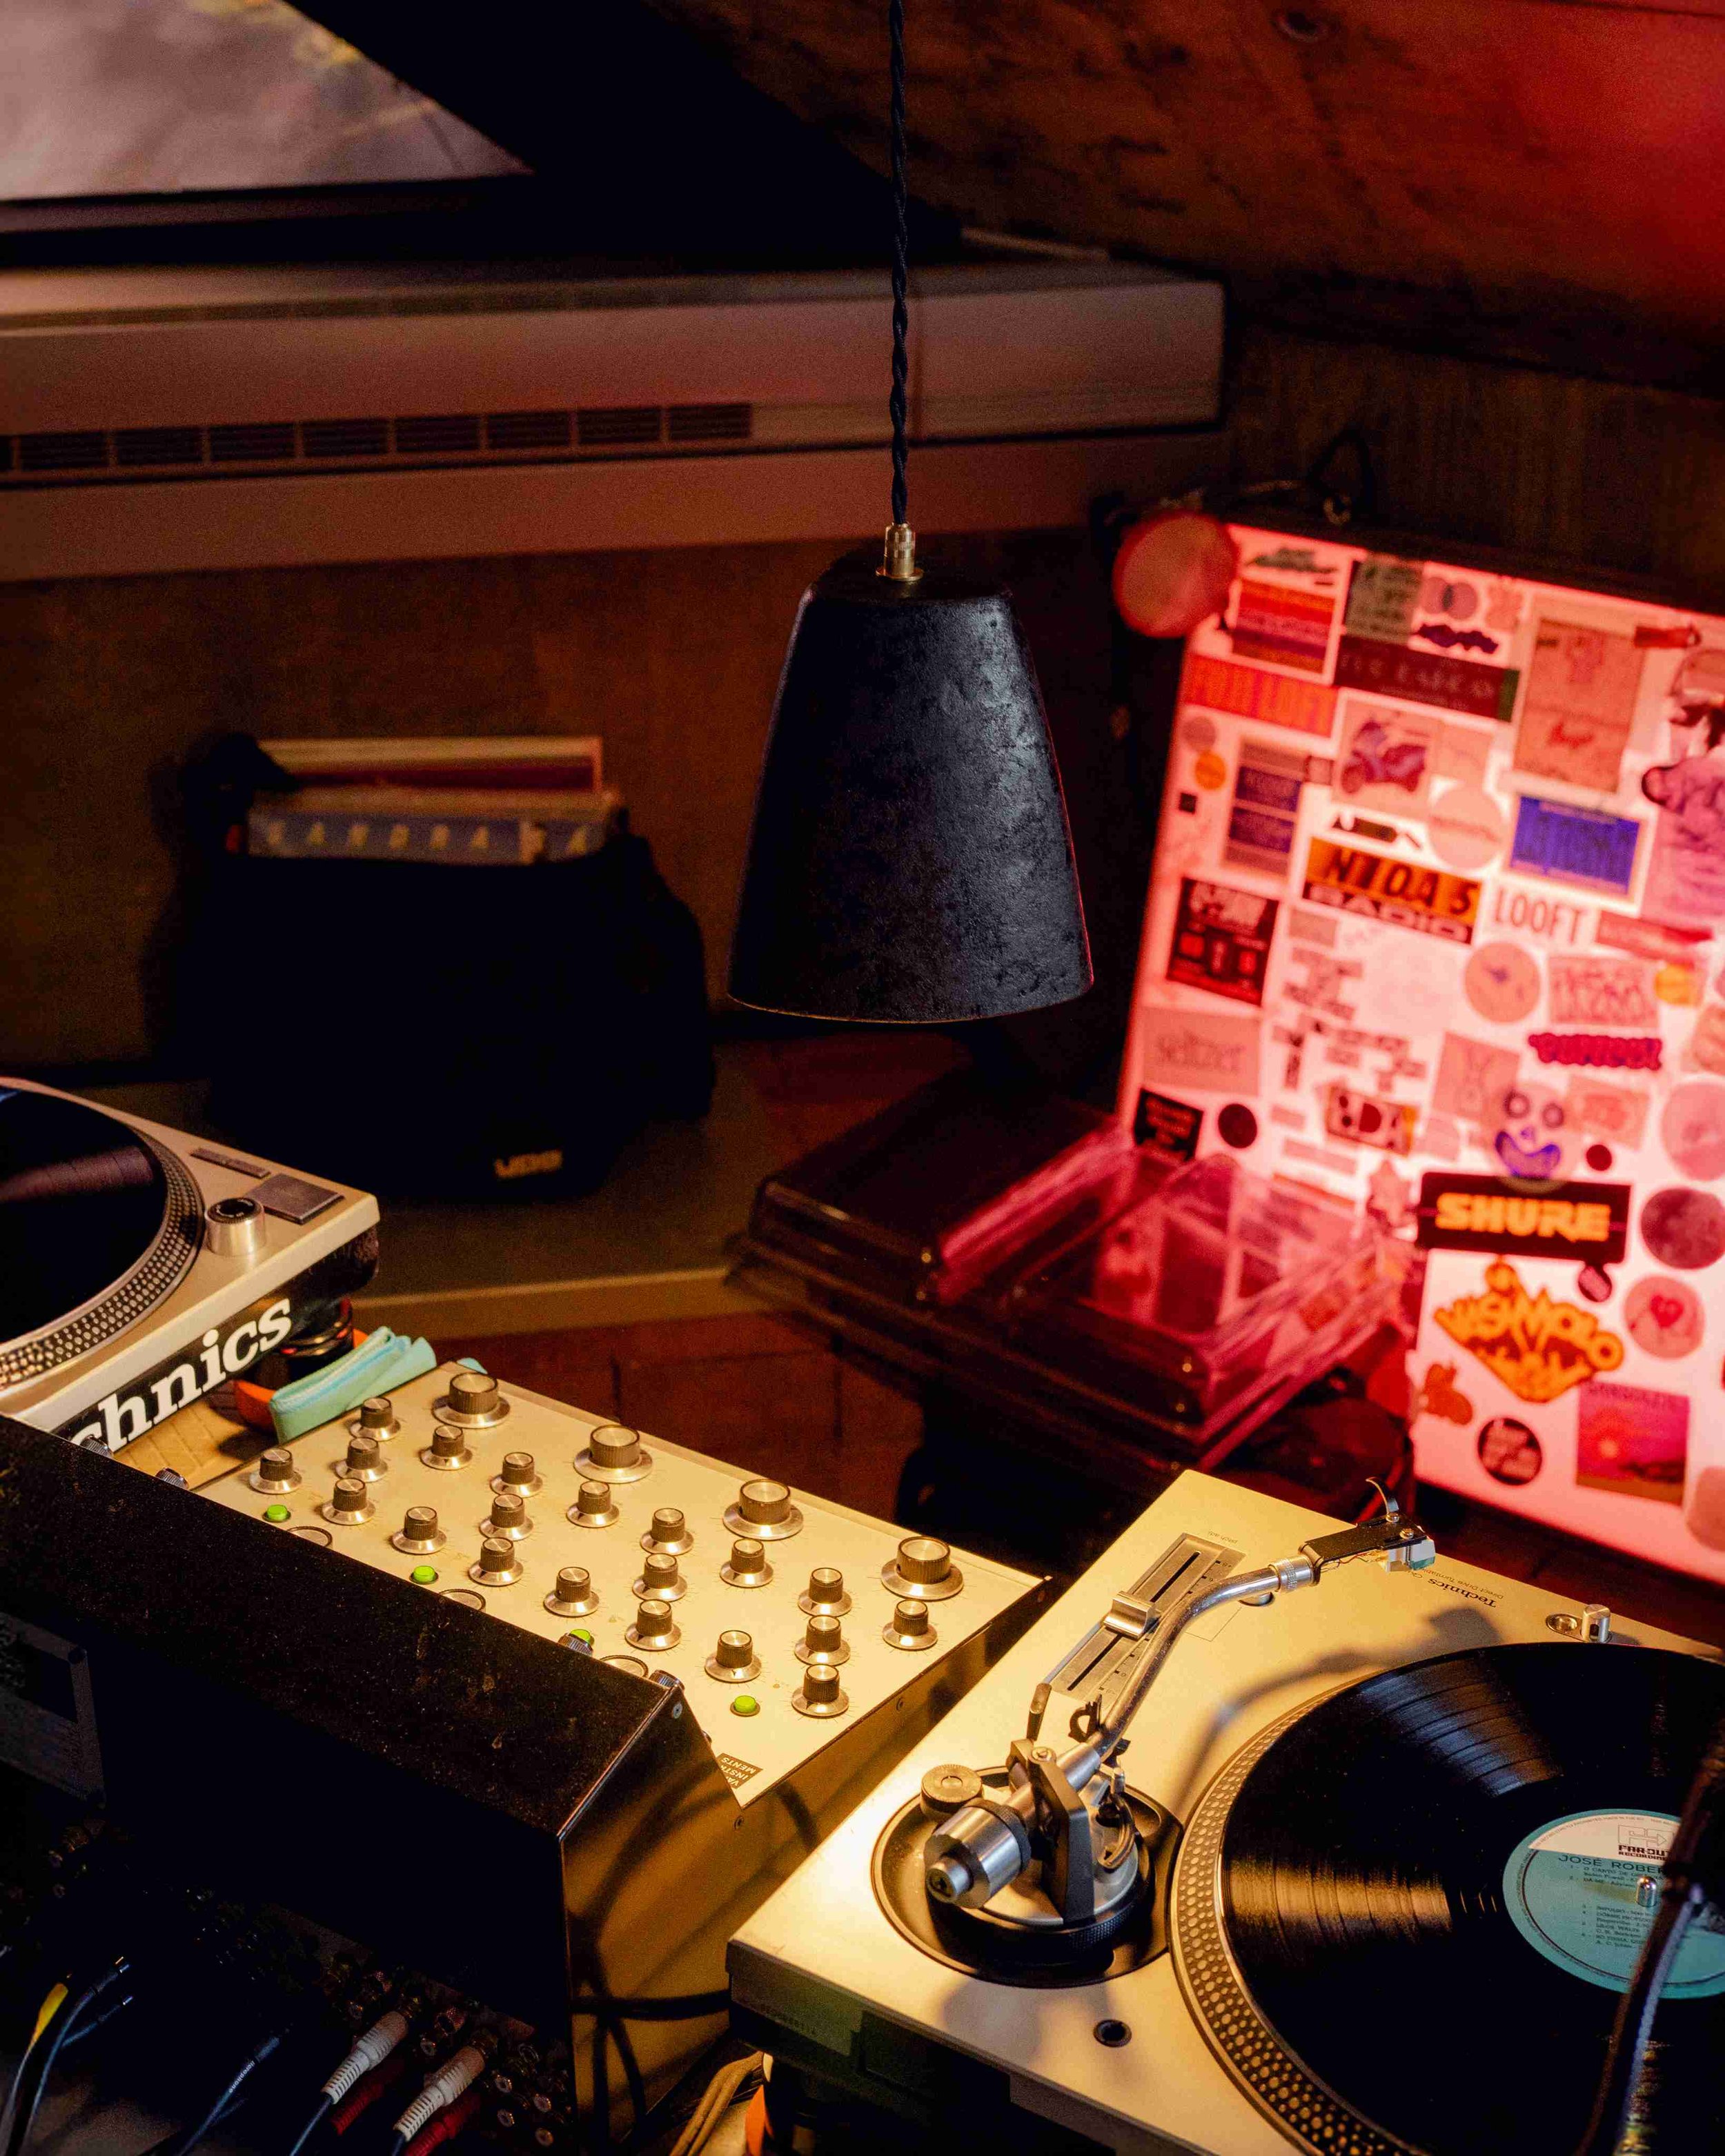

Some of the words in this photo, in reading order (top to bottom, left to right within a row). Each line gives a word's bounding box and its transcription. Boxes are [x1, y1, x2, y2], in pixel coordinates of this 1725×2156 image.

[1435, 1192, 1611, 1243] SHURE
[70, 1298, 293, 1452] chnics
[1423, 1569, 1456, 1583] Turntabl
[1457, 1579, 1479, 1591] Drive
[1428, 1578, 1497, 1608] Technics
[720, 1765, 749, 1780] INSTR
[722, 1757, 756, 1774] MENTS
[1618, 1851, 1667, 1861] RECORDIN
[1611, 1861, 1664, 1874] ROBER
